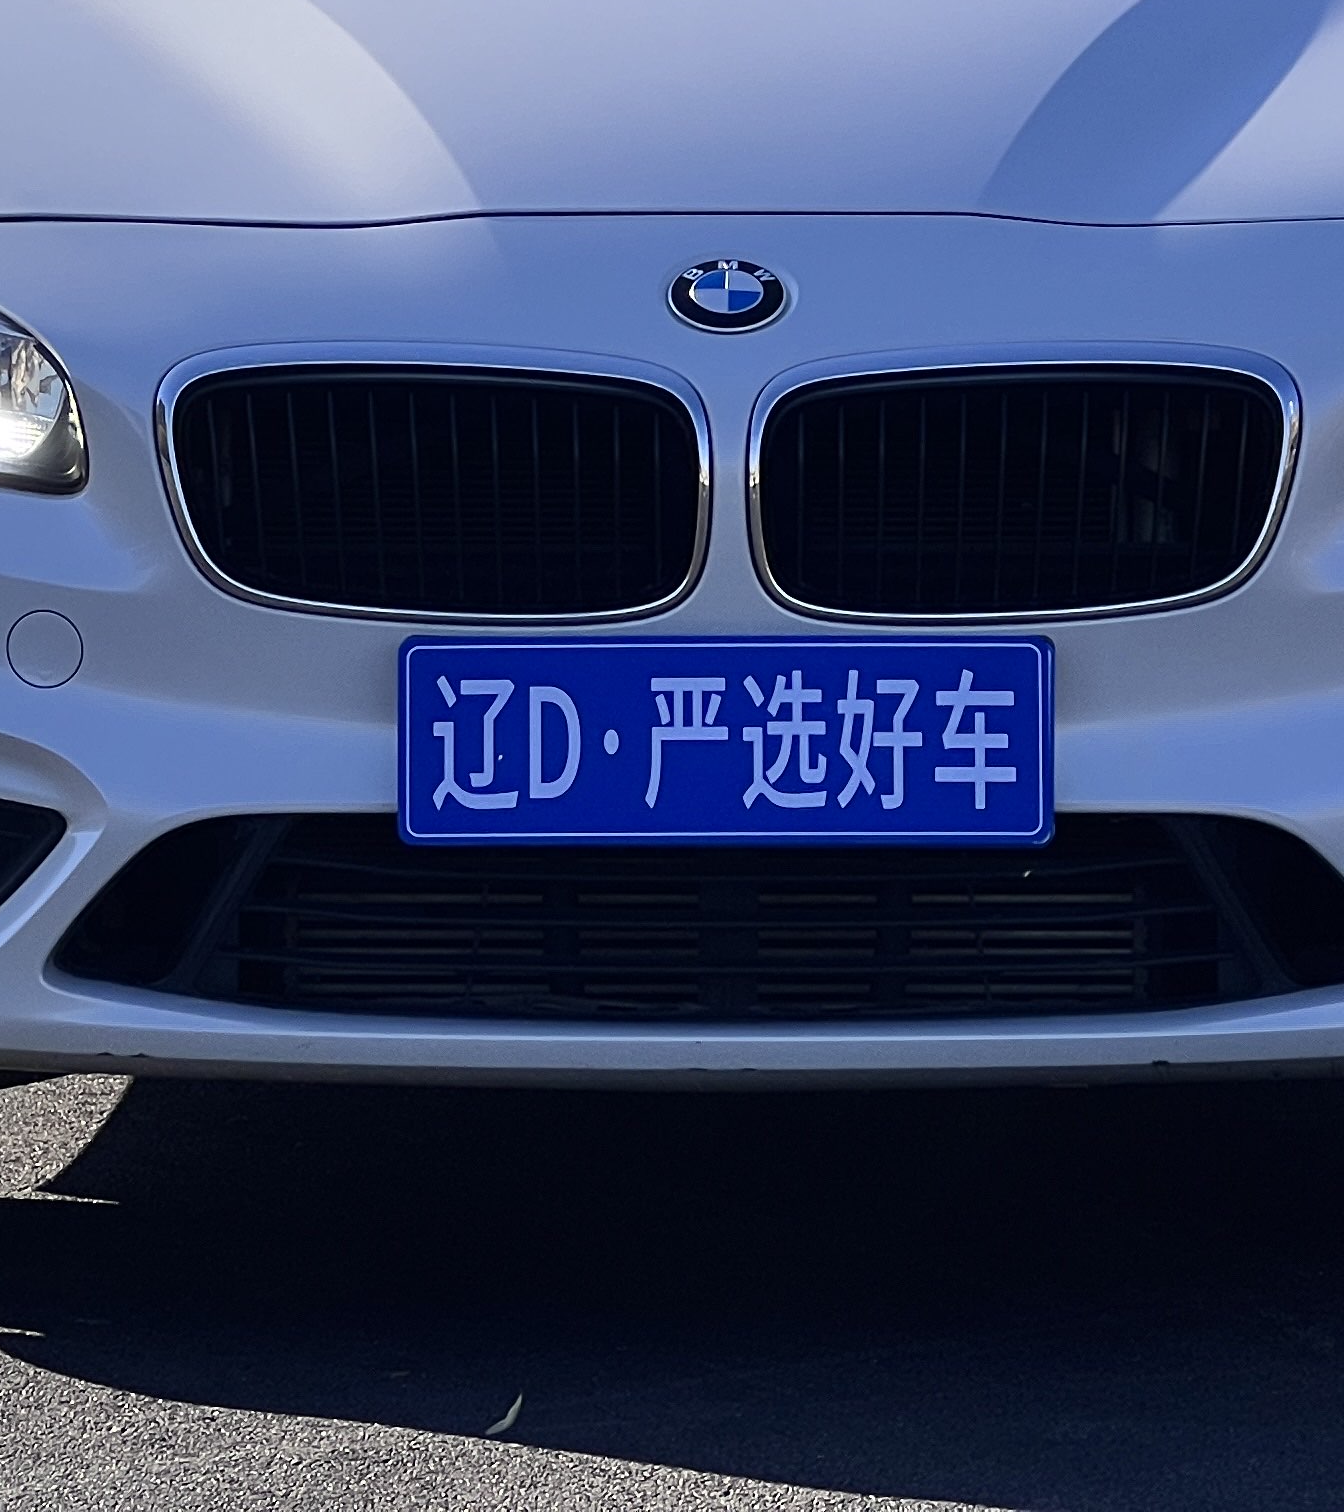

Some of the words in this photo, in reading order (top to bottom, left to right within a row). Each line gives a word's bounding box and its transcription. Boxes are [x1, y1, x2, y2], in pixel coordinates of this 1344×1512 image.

[682, 260, 776, 281] BMW
[433, 670, 1017, 810] 辽D·严选好车
